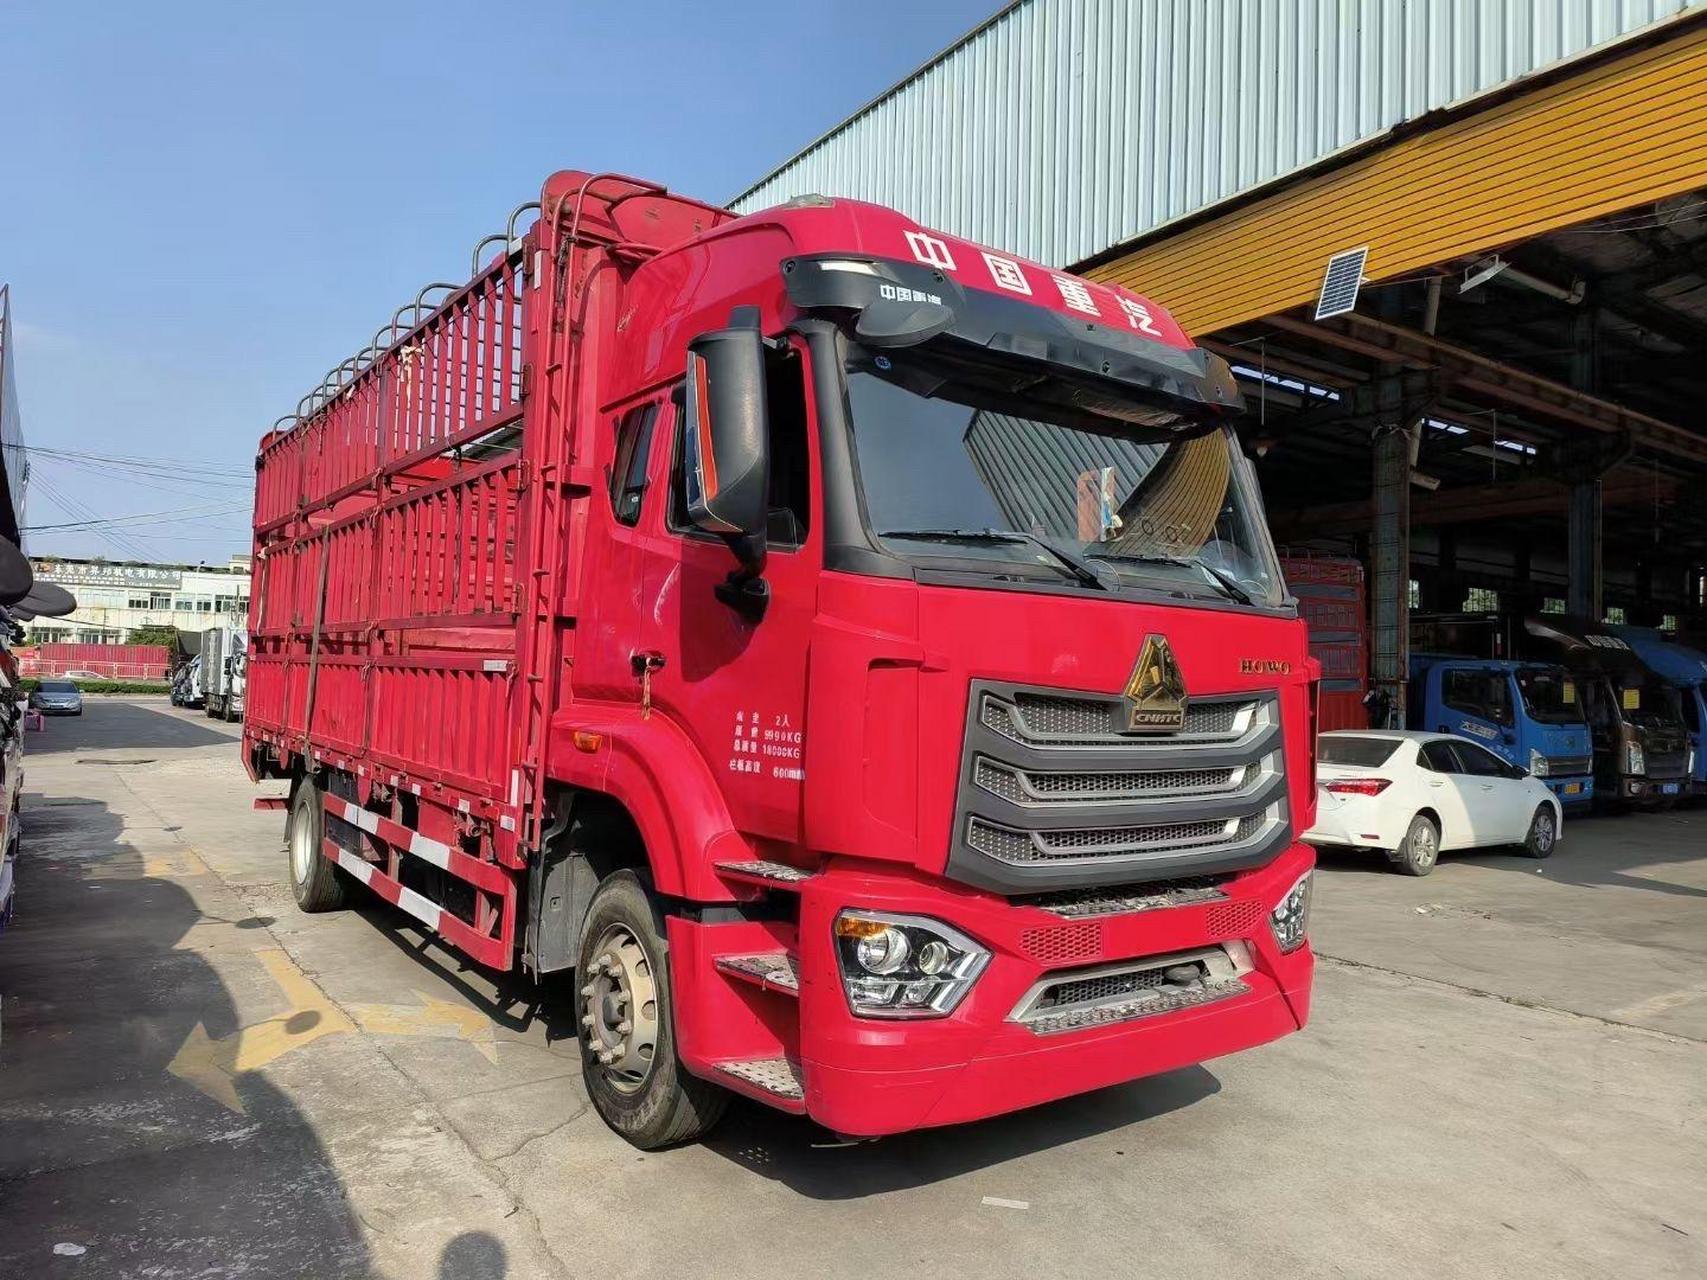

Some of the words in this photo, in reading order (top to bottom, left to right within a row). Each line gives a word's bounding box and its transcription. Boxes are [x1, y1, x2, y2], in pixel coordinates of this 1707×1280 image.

[903, 230, 1162, 336] 中国重汽
[880, 284, 942, 305] 中国重汽
[1240, 658, 1291, 675] HOWO
